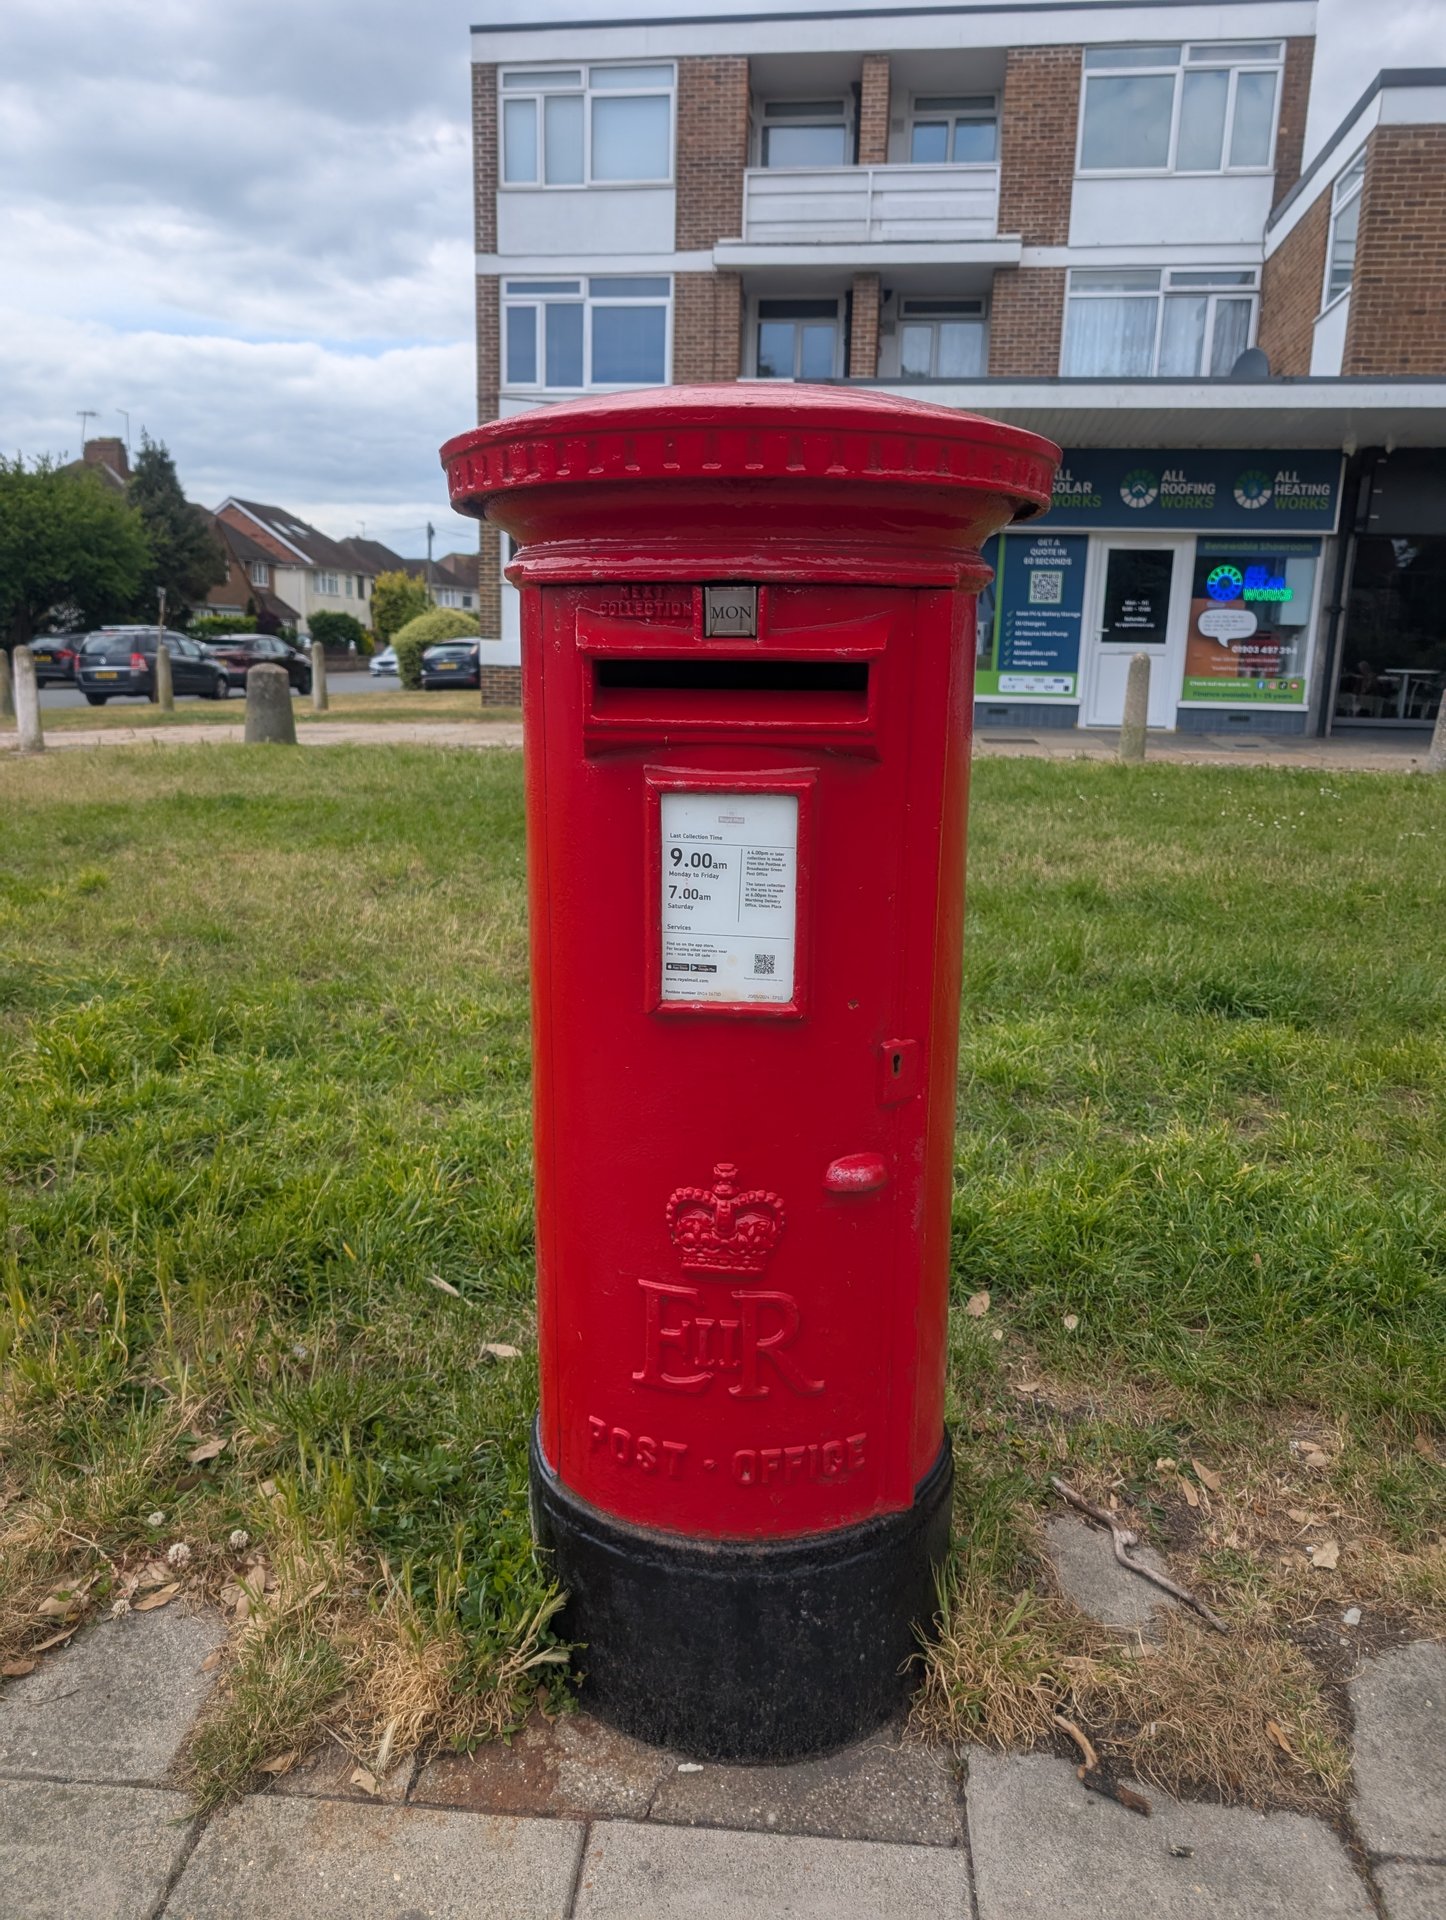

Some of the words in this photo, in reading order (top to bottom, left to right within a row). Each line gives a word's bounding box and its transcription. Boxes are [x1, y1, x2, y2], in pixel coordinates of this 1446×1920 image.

[1161, 470, 1186, 482] ALL
[1274, 471, 1300, 483] ALL
[1052, 481, 1093, 494] SOLAR
[1160, 483, 1216, 495] ROOFING
[1274, 484, 1331, 496] HEATING
[1160, 496, 1215, 509] WORKS
[1274, 497, 1329, 510] WORKS
[1030, 548, 1056, 556] QUOTE
[1035, 557, 1073, 566] SECONDS
[600, 600, 692, 618] COLLECTION
[711, 605, 752, 620] MON
[670, 847, 727, 869] 9.00am
[668, 885, 711, 901] 7.00am
[668, 902, 694, 911] Saturday
[667, 923, 691, 931] Services
[588, 1414, 688, 1479] POST
[731, 1431, 868, 1486] OFFICE
